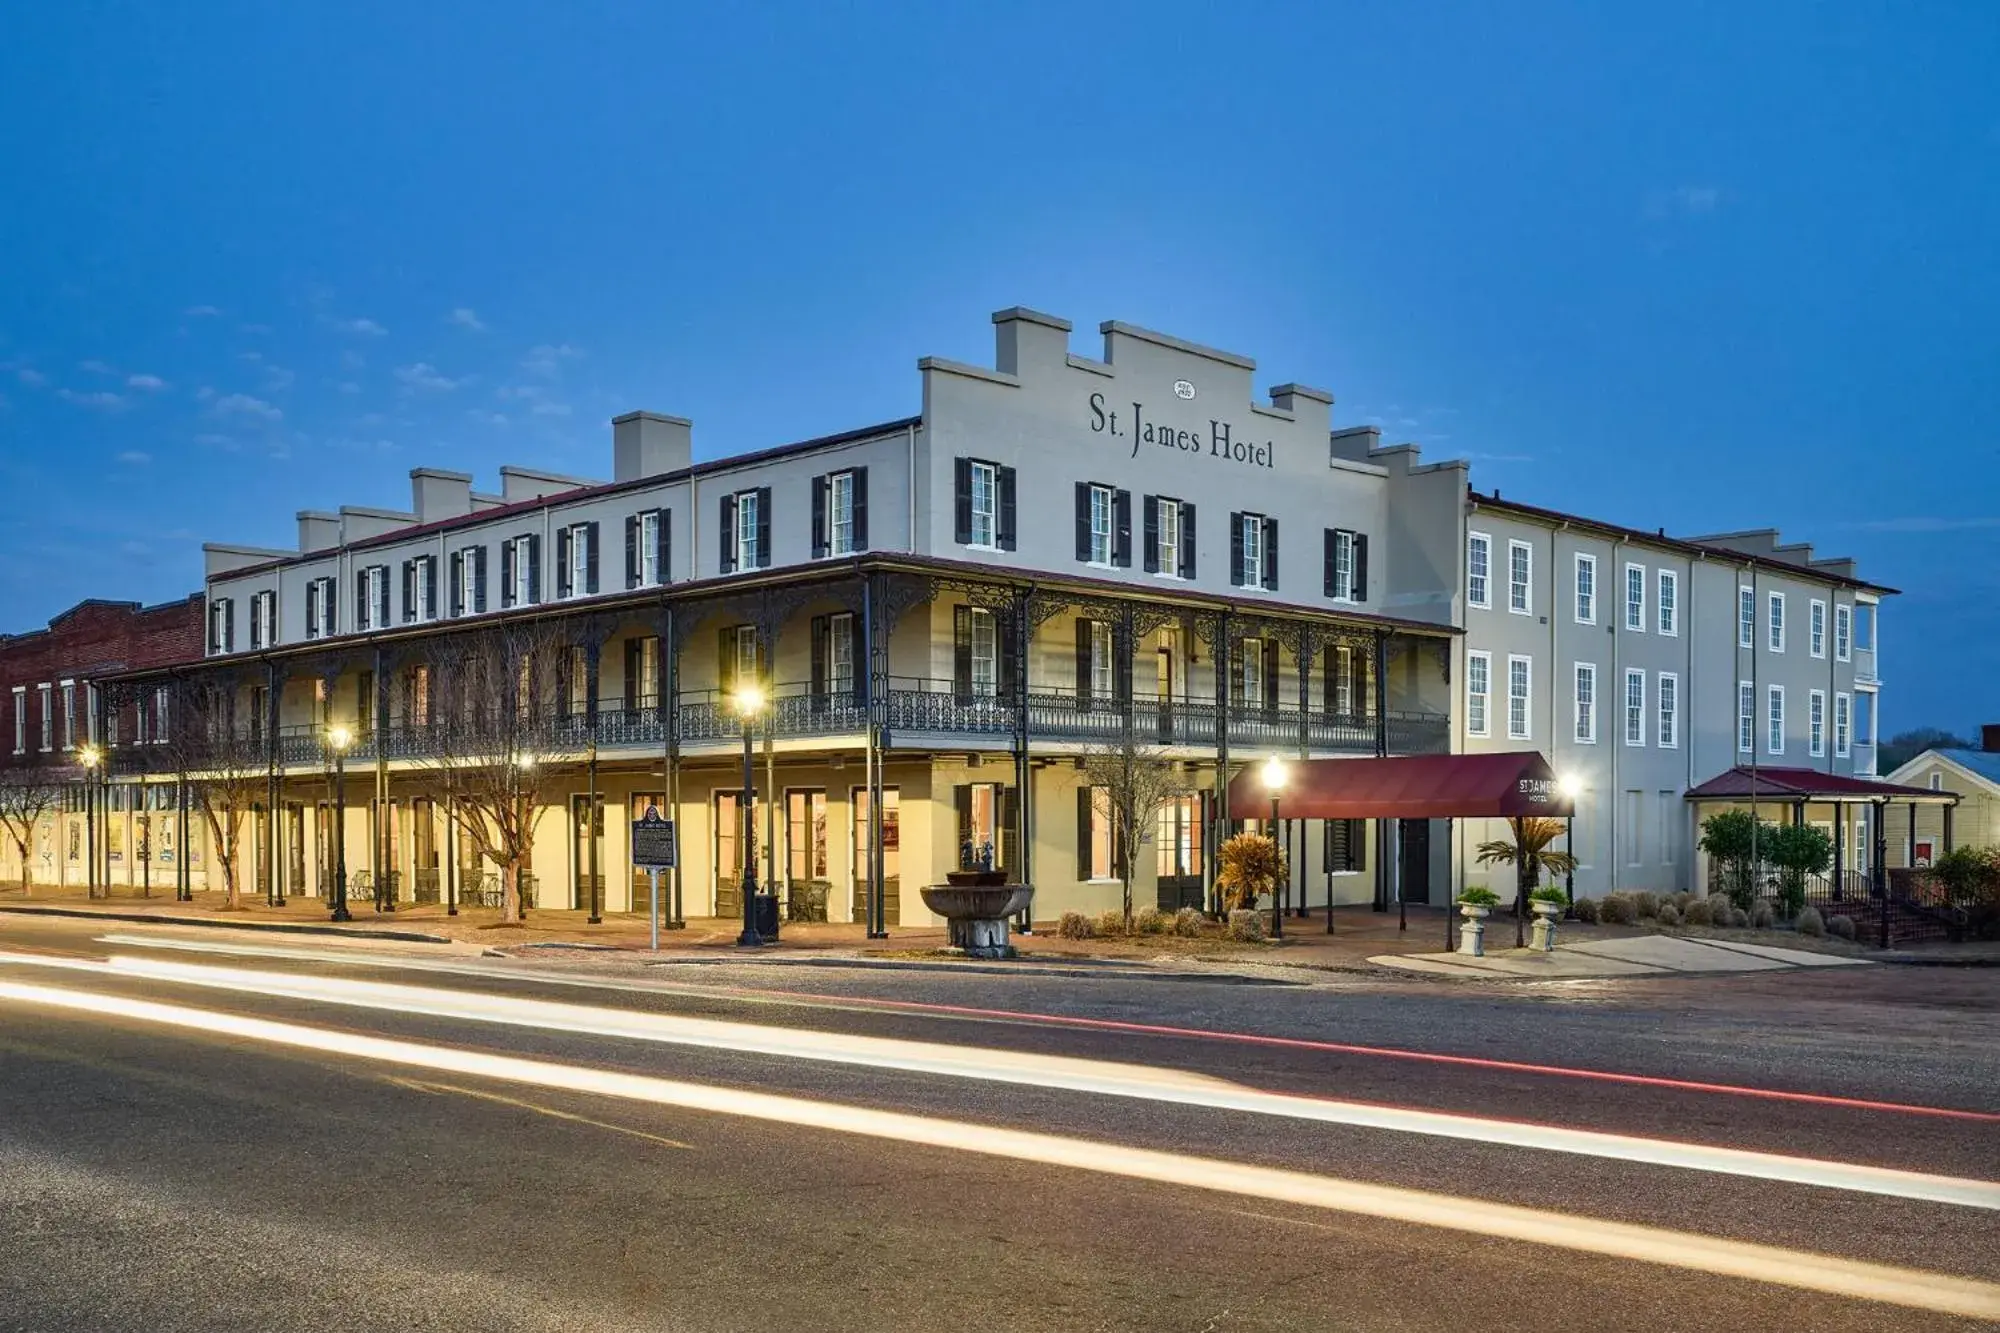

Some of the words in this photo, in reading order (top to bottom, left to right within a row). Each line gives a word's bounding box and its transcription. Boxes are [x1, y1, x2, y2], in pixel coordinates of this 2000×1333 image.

[1089, 393, 1124, 437] St.
[1131, 402, 1200, 458] James
[1209, 419, 1273, 468] Hotel
